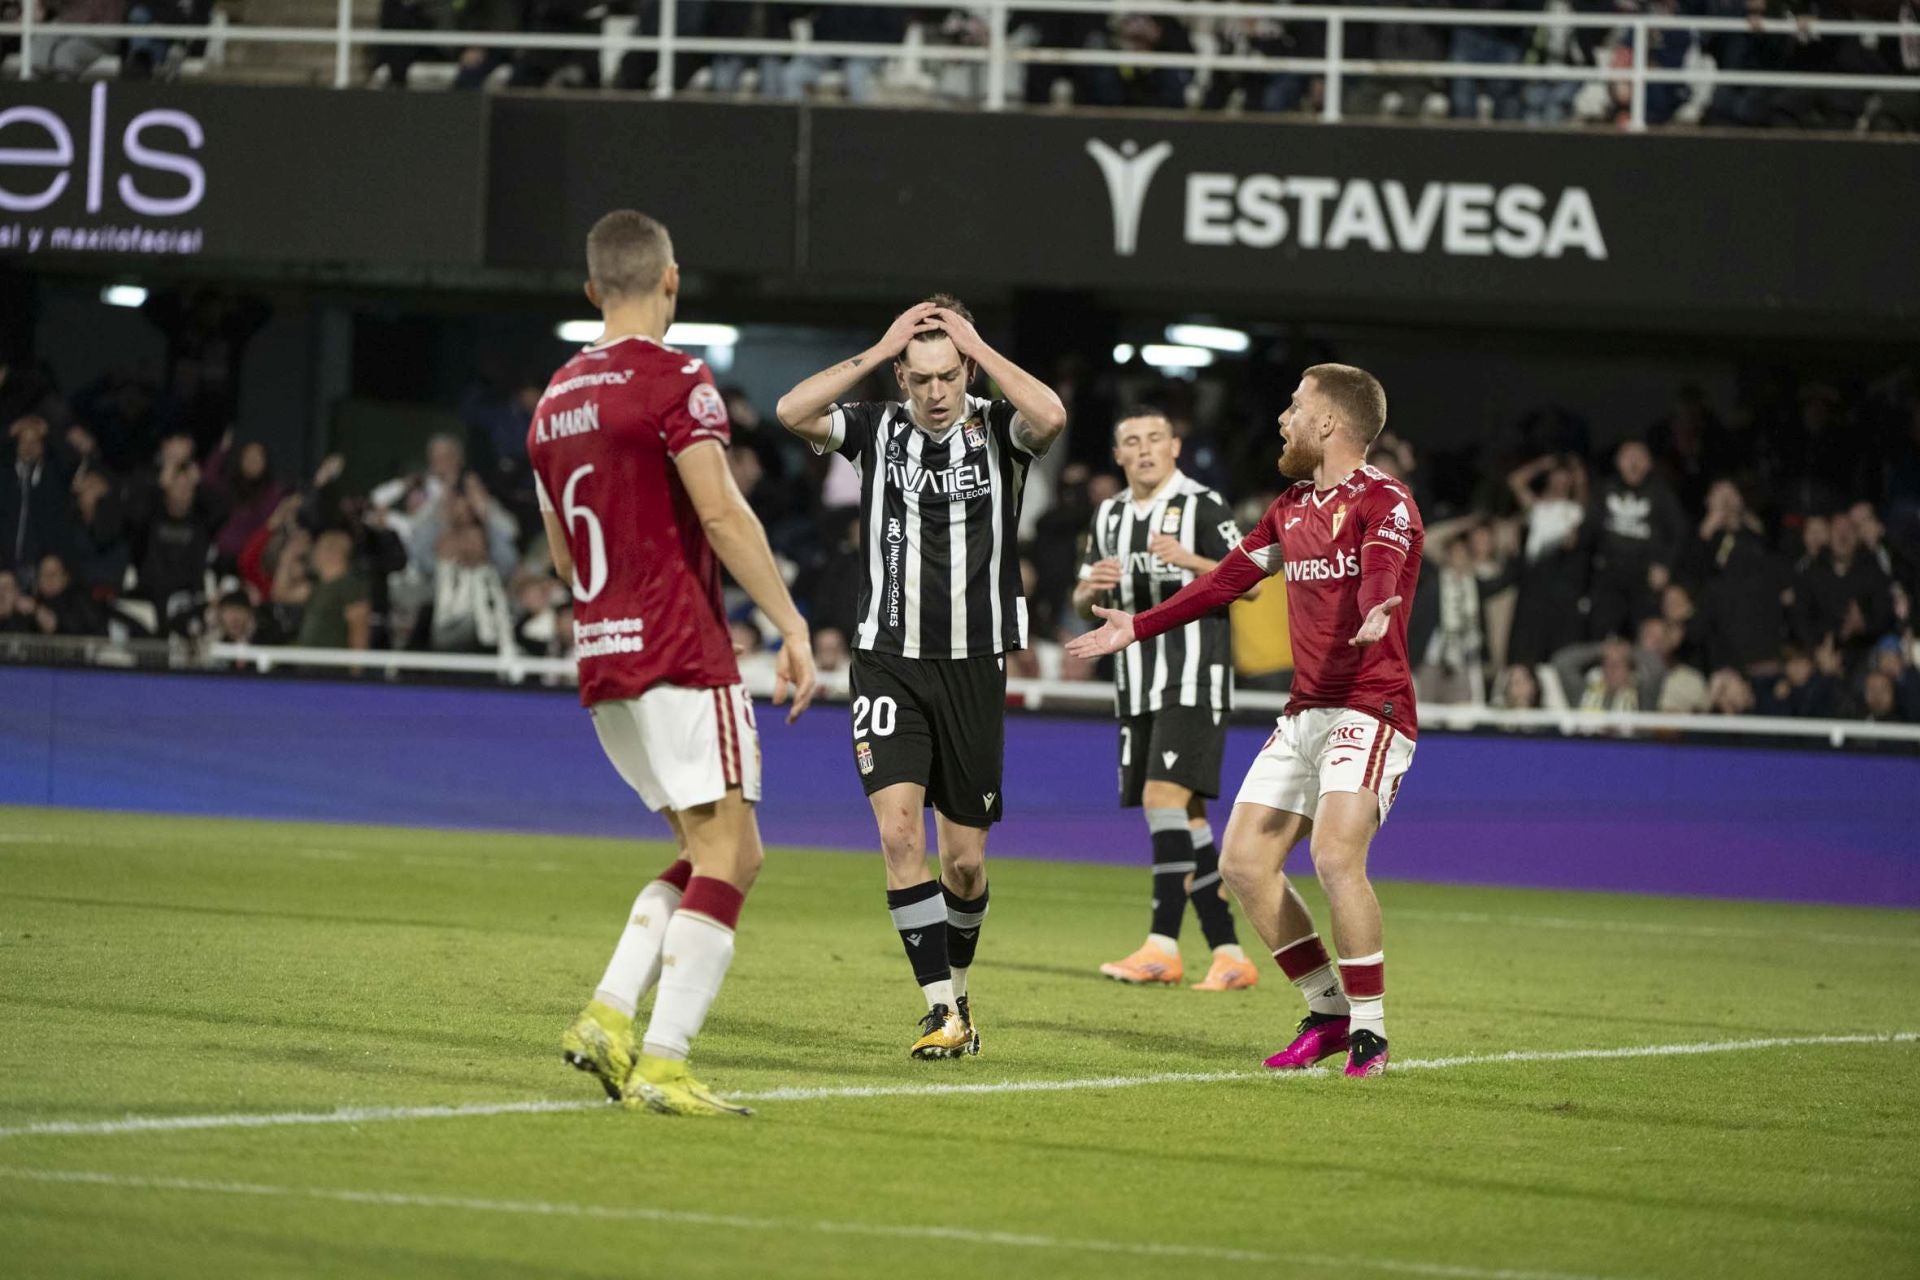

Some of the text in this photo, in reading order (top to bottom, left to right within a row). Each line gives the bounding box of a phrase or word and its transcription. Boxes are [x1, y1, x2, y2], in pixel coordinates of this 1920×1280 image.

[1184, 172, 1608, 261] ESTAVESA
[27, 226, 44, 254] y
[50, 225, 204, 255] maxilofacial
[551, 399, 599, 440] MARÍN
[949, 485, 991, 502] TELECOM
[562, 463, 608, 602] 6
[853, 695, 897, 740] 20
